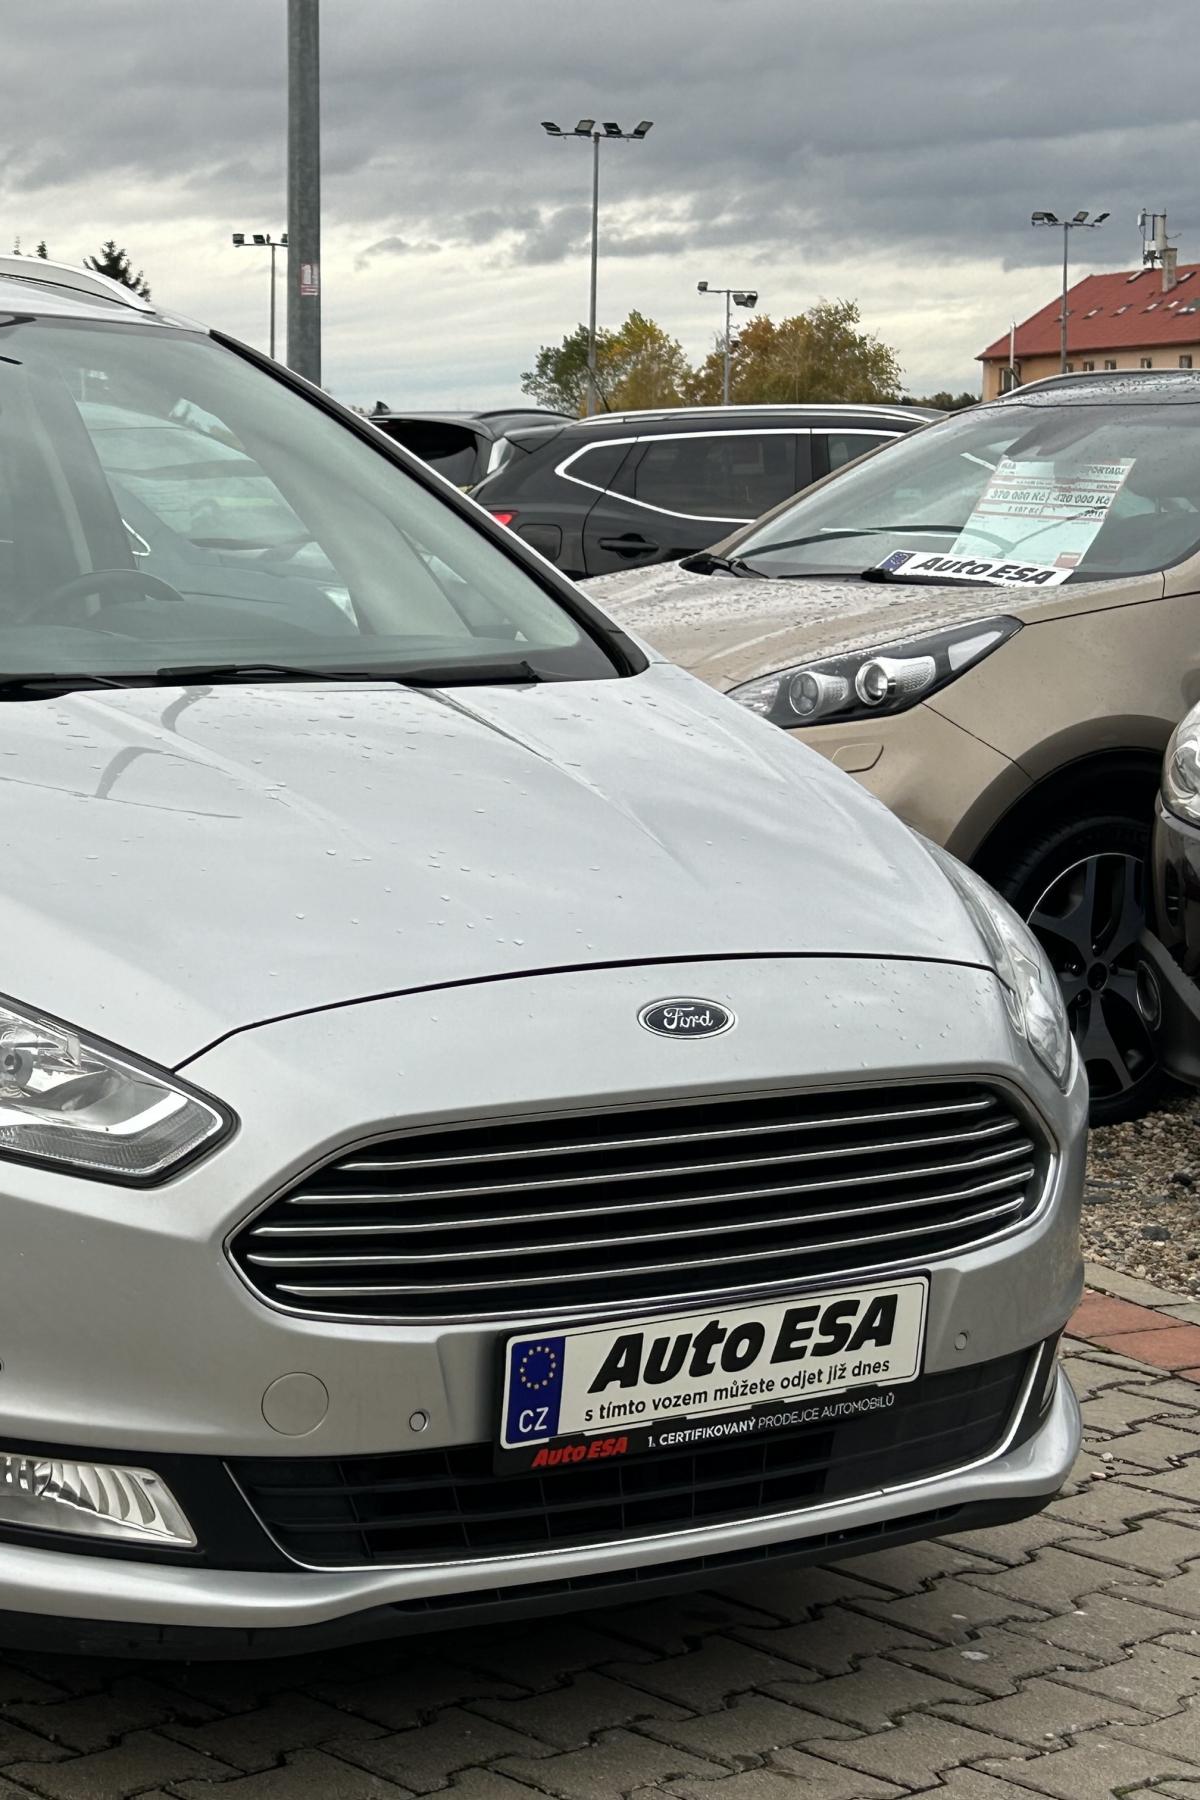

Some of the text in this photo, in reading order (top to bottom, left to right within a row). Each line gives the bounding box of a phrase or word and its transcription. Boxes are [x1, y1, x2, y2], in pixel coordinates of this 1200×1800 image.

[911, 556, 1057, 585] Auto ESA
[663, 1006, 714, 1029] Ford
[587, 1294, 898, 1394] Auto ESA
[585, 1409, 594, 1422] s
[599, 1399, 646, 1420] tímto
[652, 1390, 708, 1411] vozem
[714, 1378, 775, 1402] můžete
[781, 1368, 824, 1390] odjet
[852, 1360, 890, 1377] dnes
[519, 1406, 550, 1433] CZ
[659, 1416, 756, 1446] CERTIFIKOVANÝ
[758, 1408, 819, 1429] PRODEJCE
[821, 1392, 895, 1418] AUTOMOBILŮ
[531, 1437, 629, 1469] Auto ESA
